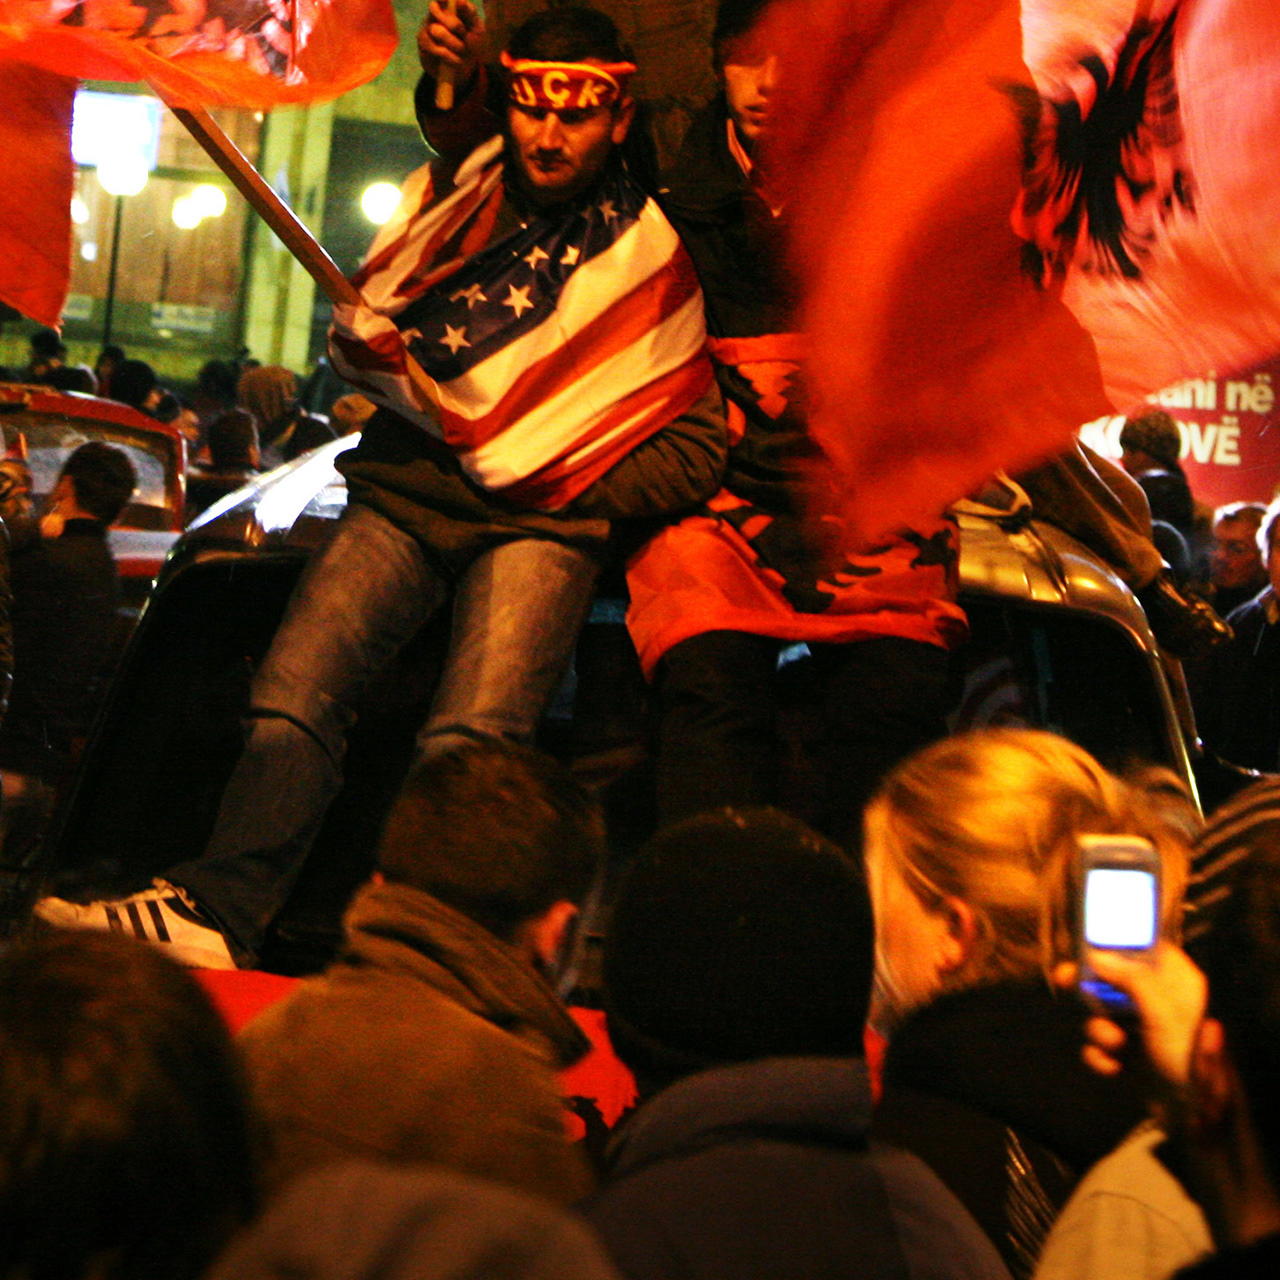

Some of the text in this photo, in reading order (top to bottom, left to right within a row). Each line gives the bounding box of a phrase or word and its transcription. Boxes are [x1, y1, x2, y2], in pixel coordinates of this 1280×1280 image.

[512, 70, 609, 109] UÇK
[1145, 370, 1275, 413] ani në
